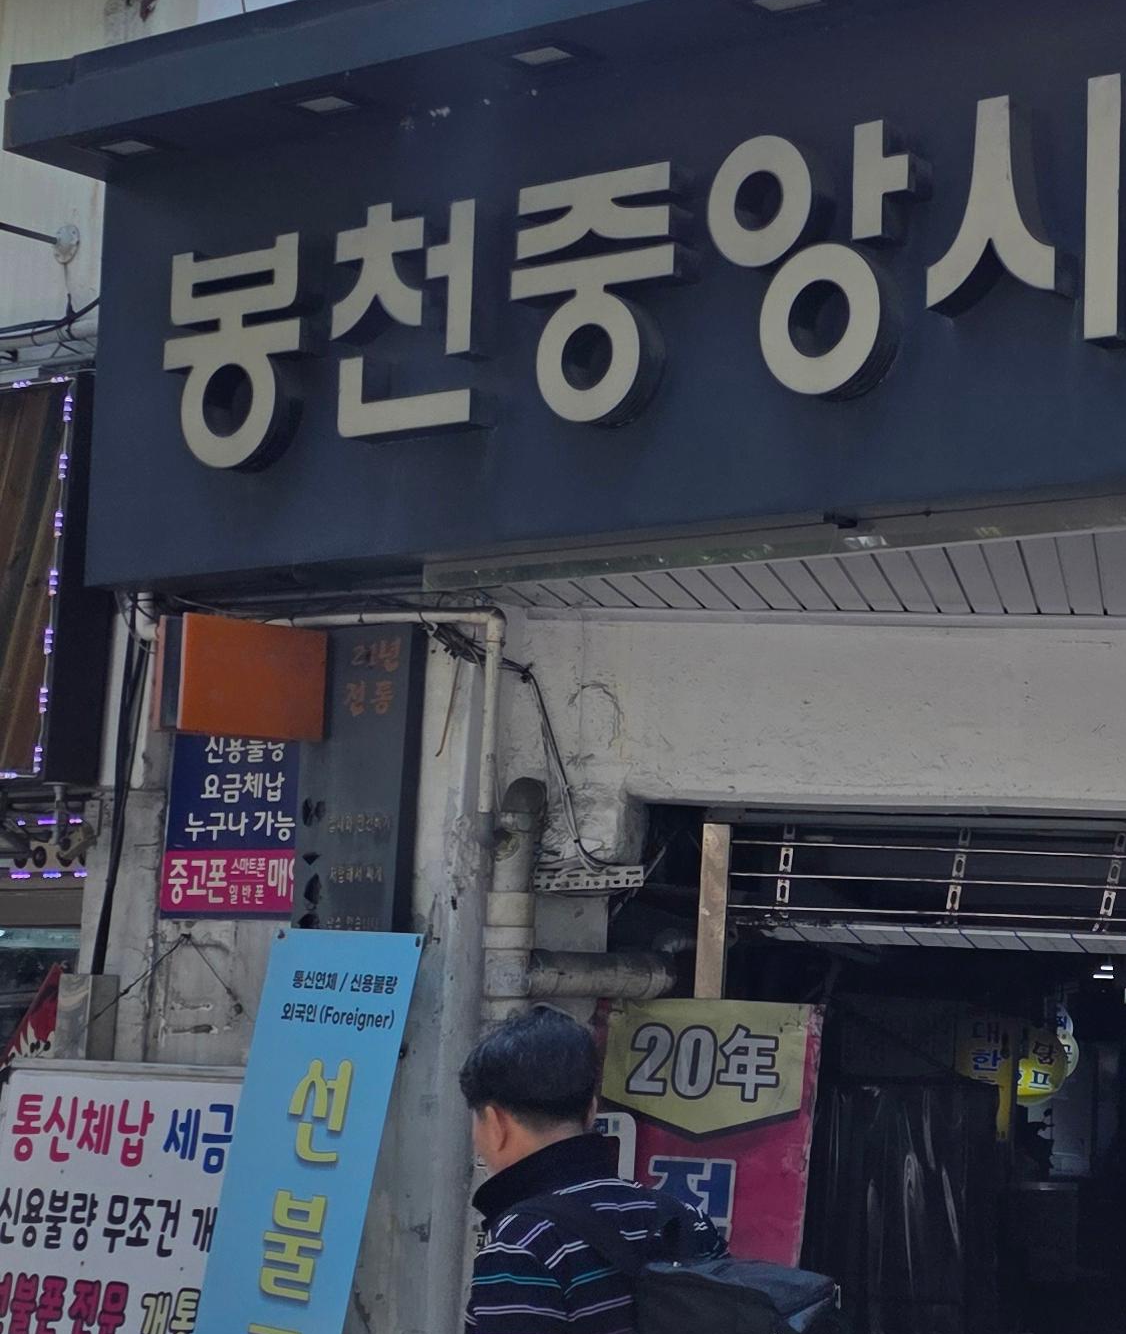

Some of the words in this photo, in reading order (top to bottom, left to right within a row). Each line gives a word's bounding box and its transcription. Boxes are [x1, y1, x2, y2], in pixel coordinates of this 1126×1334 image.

[200, 771, 286, 803] 요금체납
[184, 811, 249, 842] 누구나
[252, 810, 296, 842] 가능
[167, 858, 228, 905] 중고폰
[229, 857, 266, 878] 스마트폰
[292, 970, 338, 991] 통신연체
[350, 974, 398, 994] 신용불량
[281, 1003, 318, 1023] 외국인
[319, 1006, 395, 1031] (Foreigner)
[624, 1021, 781, 1104] 20年
[12, 1094, 155, 1167] 통신체납
[162, 1103, 234, 1174] 세금
[0, 1187, 99, 1251] 신용불량
[103, 1195, 181, 1258] 무조건
